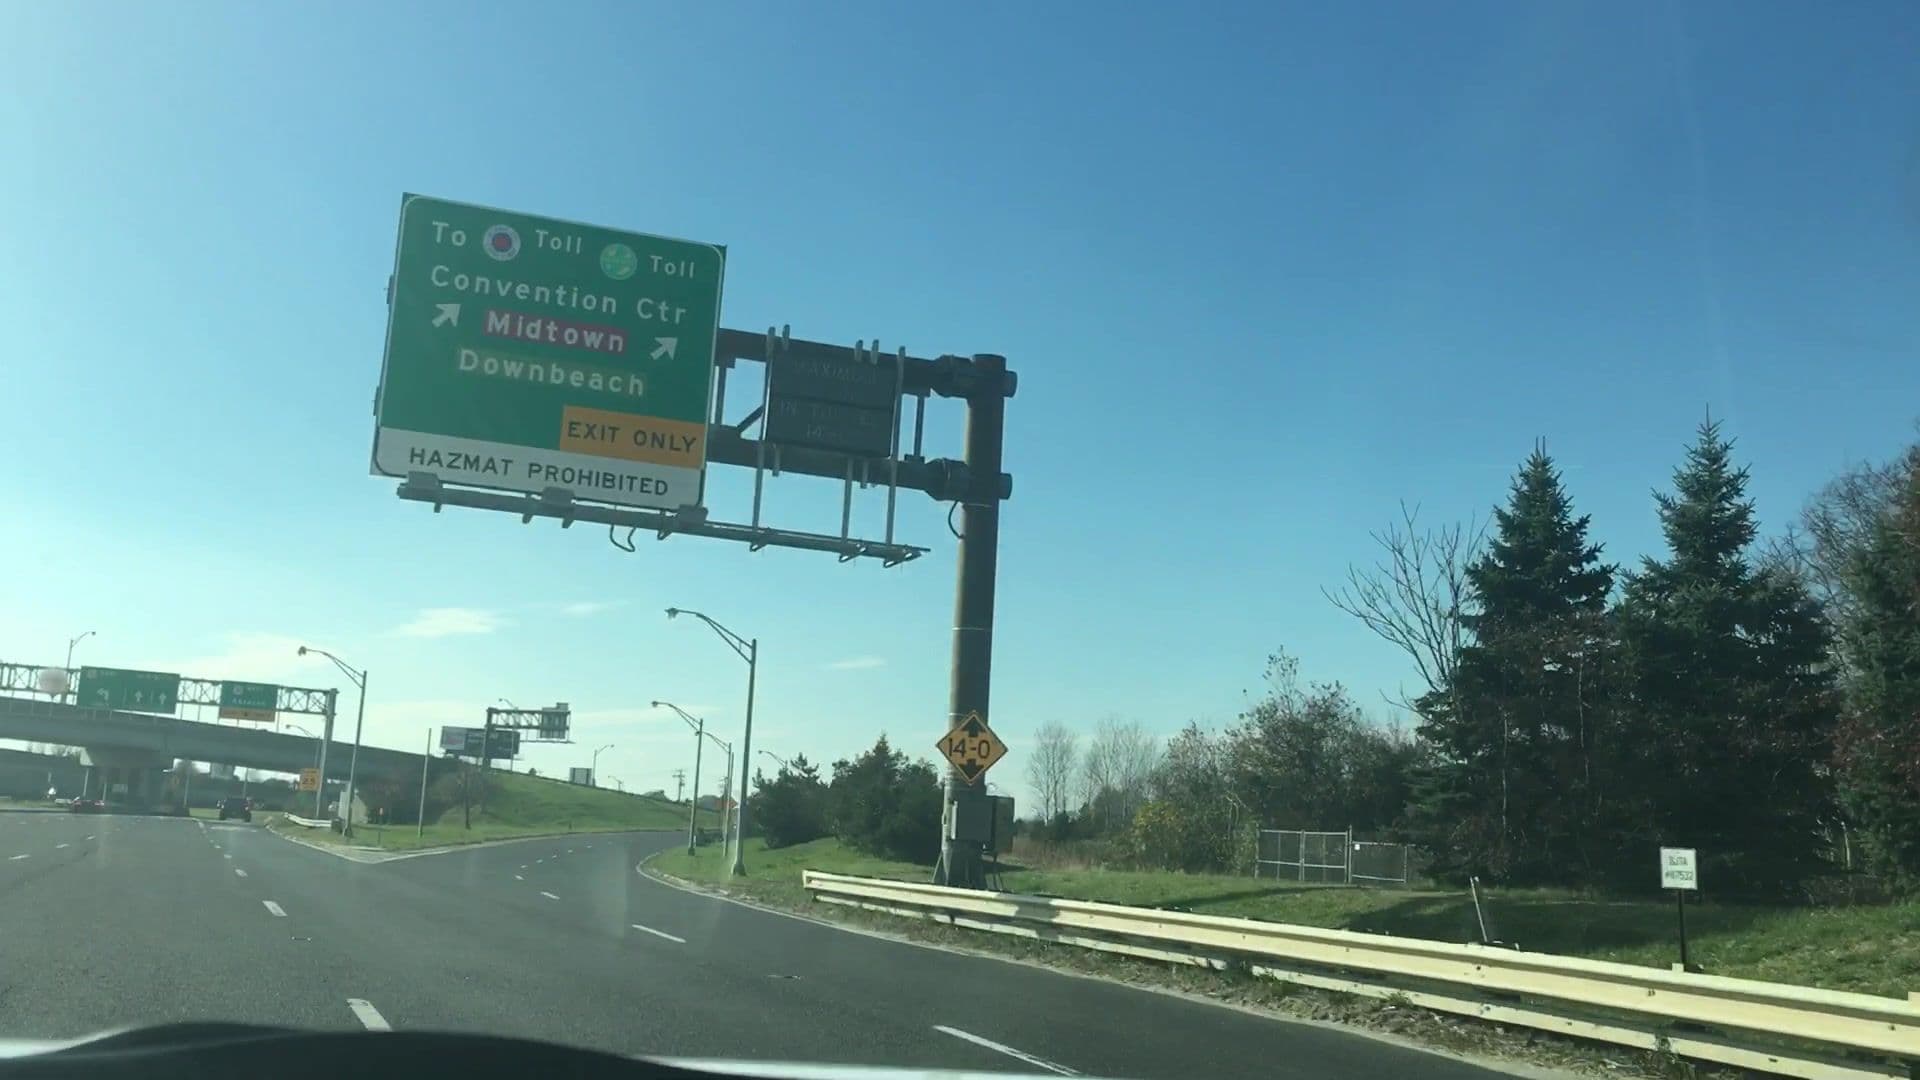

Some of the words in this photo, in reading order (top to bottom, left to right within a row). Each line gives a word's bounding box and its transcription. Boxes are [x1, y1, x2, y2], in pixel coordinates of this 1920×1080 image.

[432, 221, 467, 248] To
[535, 229, 583, 255] Toll
[650, 255, 695, 279] Toll
[431, 264, 617, 314] Convention
[636, 297, 687, 325] Ctr
[486, 310, 625, 353] Midtown
[458, 349, 645, 397] Downbeach
[567, 421, 621, 444] EXIT
[633, 430, 697, 454] ONLY
[409, 447, 514, 477] HAZMAT
[528, 463, 669, 497] PROHIBITED
[948, 737, 991, 760] 14-0
